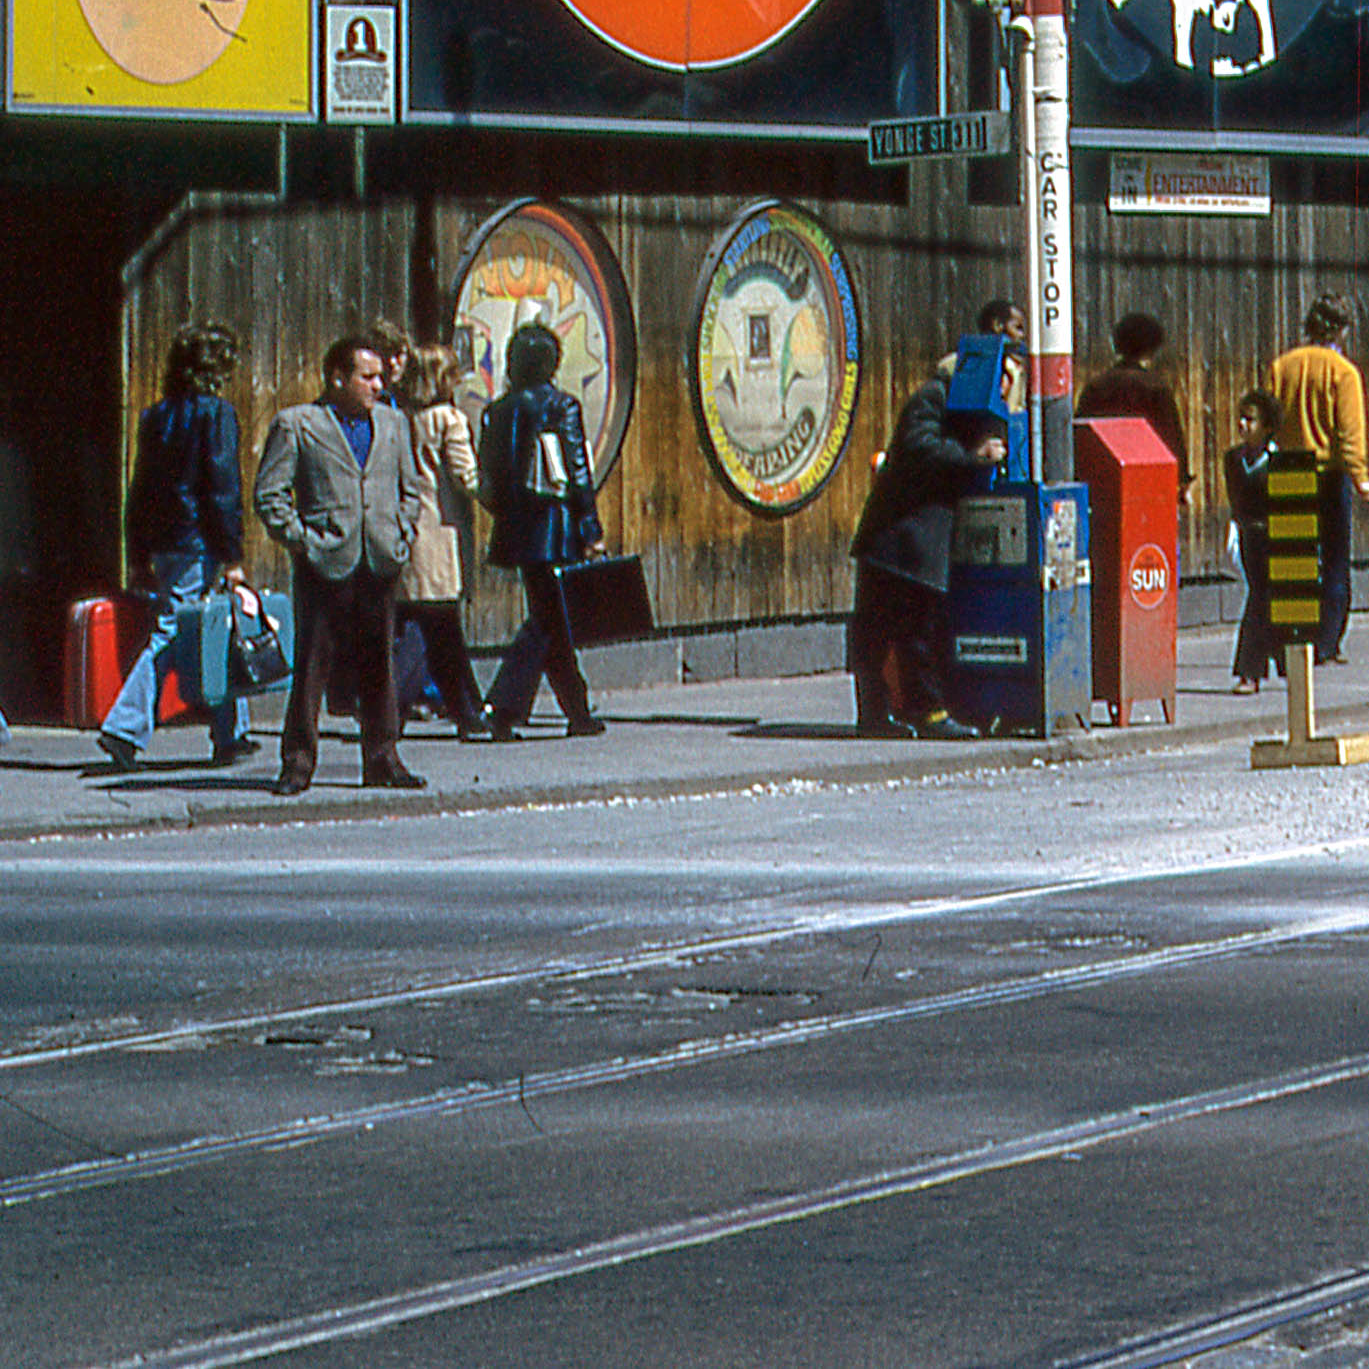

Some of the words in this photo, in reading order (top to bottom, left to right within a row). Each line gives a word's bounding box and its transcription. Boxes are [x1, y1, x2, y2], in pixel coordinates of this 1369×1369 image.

[874, 126, 923, 155] YONGE
[1040, 151, 1058, 221] CAR
[1153, 173, 1259, 196] ENTERTAINMENT
[1044, 232, 1061, 327] STOP
[1132, 568, 1166, 591] SUN
